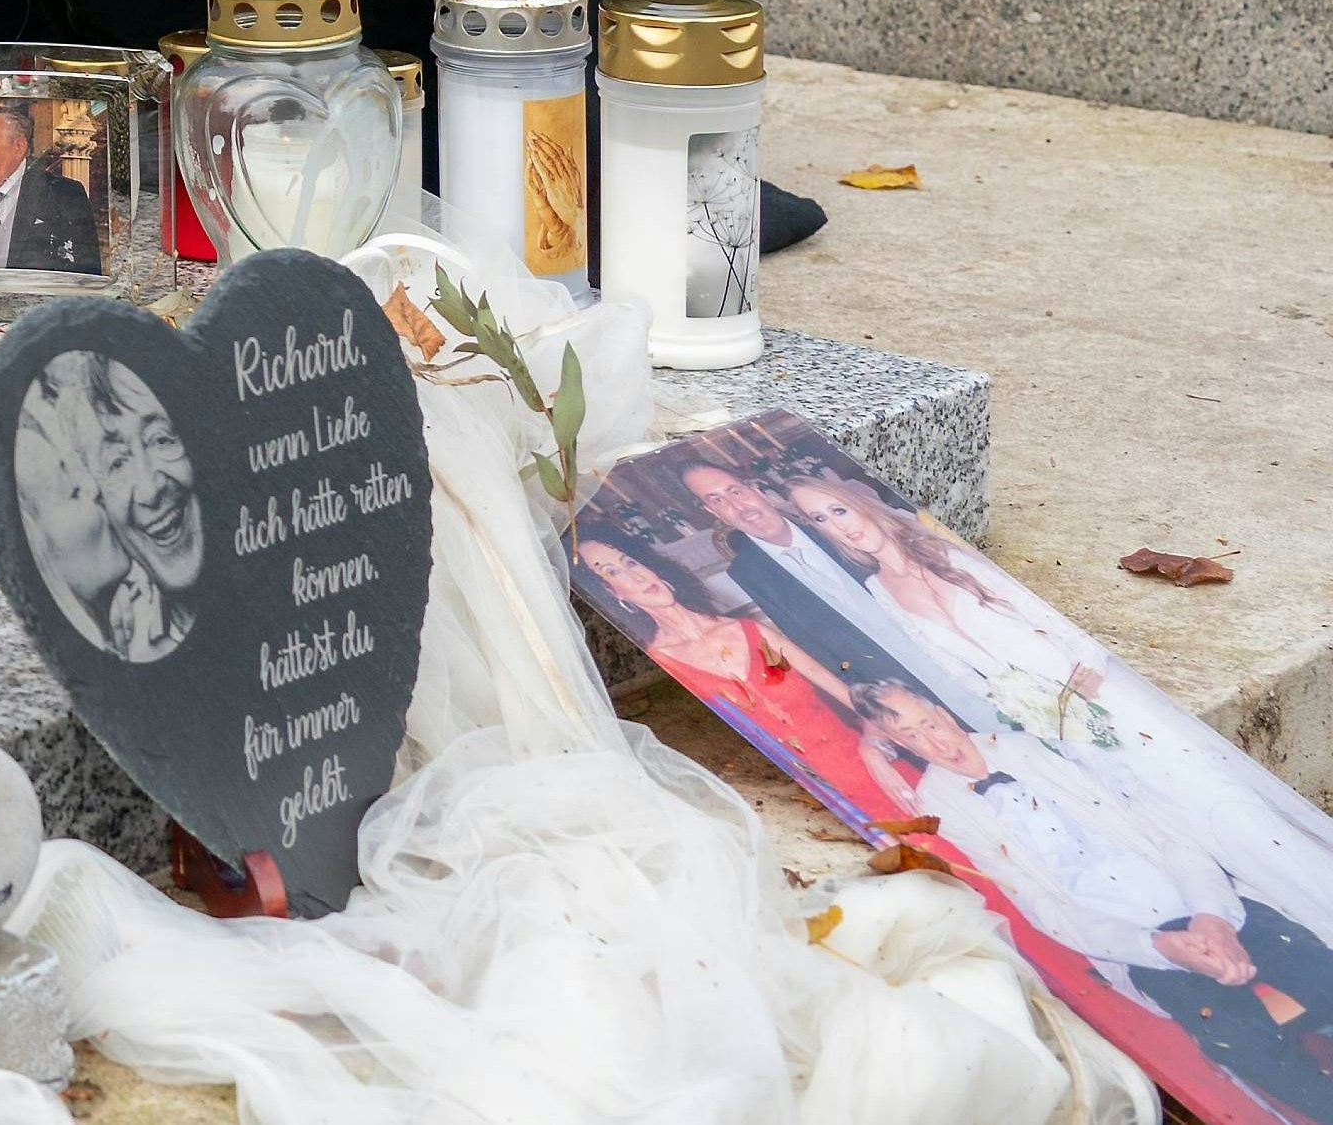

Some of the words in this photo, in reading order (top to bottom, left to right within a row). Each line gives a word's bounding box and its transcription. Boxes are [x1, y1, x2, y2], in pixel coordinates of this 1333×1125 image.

[234, 308, 367, 402] Richard,
[248, 430, 309, 472] wenn
[313, 396, 370, 452] Liebe
[235, 496, 286, 556] dich
[291, 478, 347, 535] hätte
[350, 461, 412, 514] retten
[259, 619, 337, 691] hättest
[342, 610, 374, 660] du
[244, 715, 283, 781] für
[286, 692, 360, 749] immer
[280, 754, 353, 849] gelebt.
